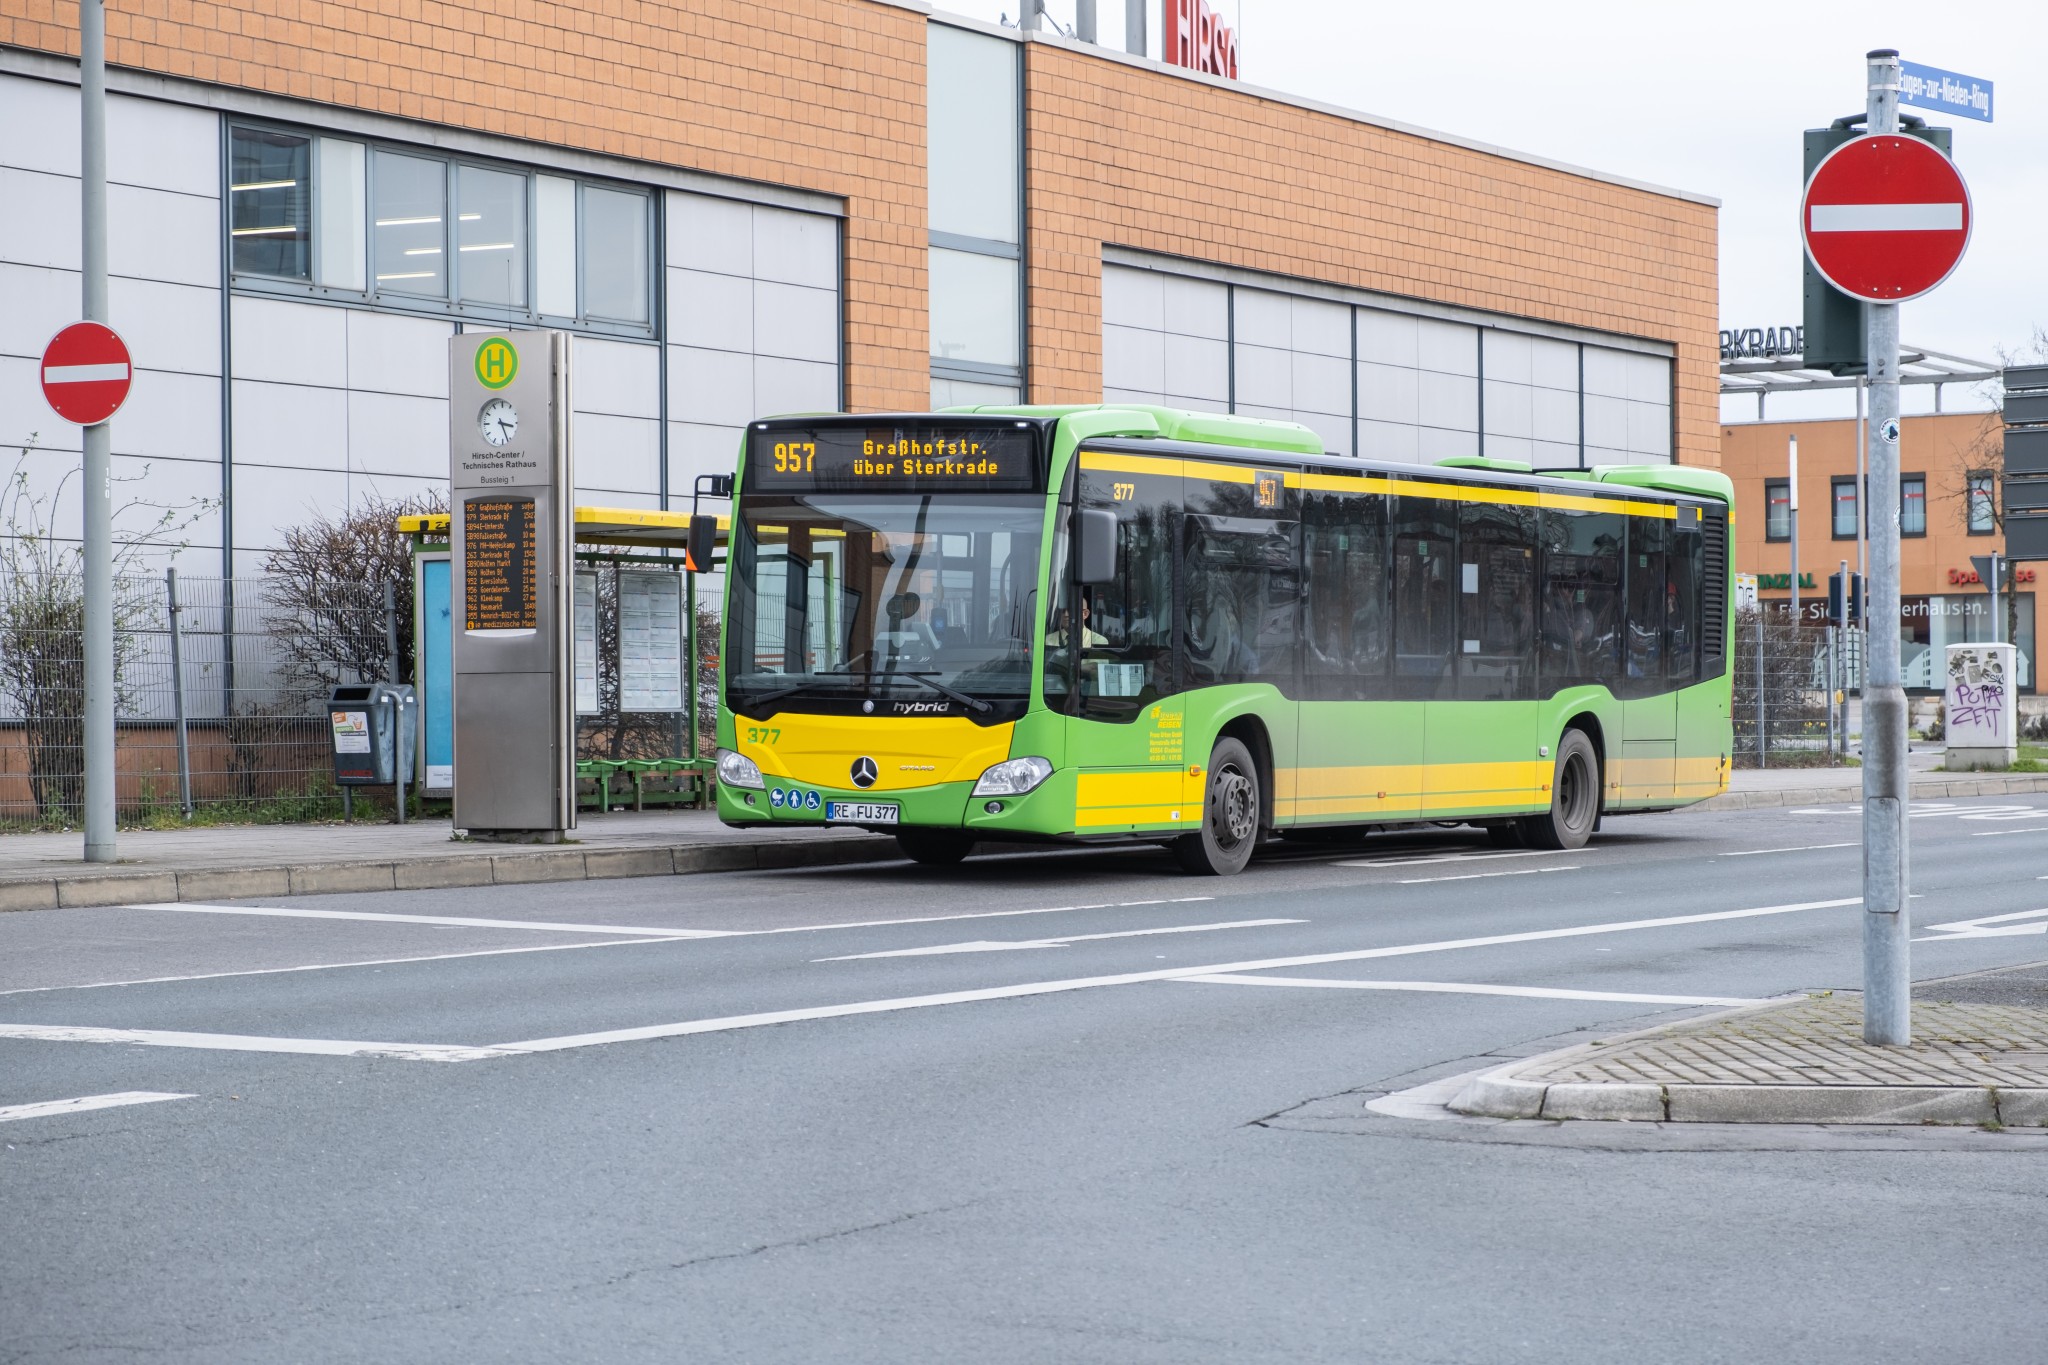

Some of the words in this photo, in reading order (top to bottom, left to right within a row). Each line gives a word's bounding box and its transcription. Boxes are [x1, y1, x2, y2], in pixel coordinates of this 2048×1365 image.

[1899, 66, 1989, 117] Eugen-zur-Nieden-Ring
[1720, 326, 1804, 360] RKRADE
[472, 451, 521, 460] Hirsch-Center
[863, 439, 987, 457] Graßhofstr.
[462, 462, 504, 470] Technisches
[505, 460, 537, 468] Rathaus
[774, 443, 815, 473] 957
[854, 459, 894, 475] über
[903, 459, 998, 475] Sterkrade
[480, 475, 509, 484] Bussteig
[510, 475, 515, 483] 1
[1113, 482, 1135, 500] 377
[1259, 479, 1277, 507] 957
[466, 503, 476, 512] 957
[521, 502, 535, 511] sofor
[466, 513, 477, 521] 979
[1757, 573, 1817, 590] INZAL
[1948, 568, 2036, 587] Spase
[1779, 603, 1806, 619] Fr
[1901, 600, 1988, 617] erhausen.
[893, 701, 950, 714] hybrid
[747, 727, 781, 744] 377
[834, 804, 849, 818] RE
[857, 805, 872, 819] FU
[874, 806, 897, 819] 377
